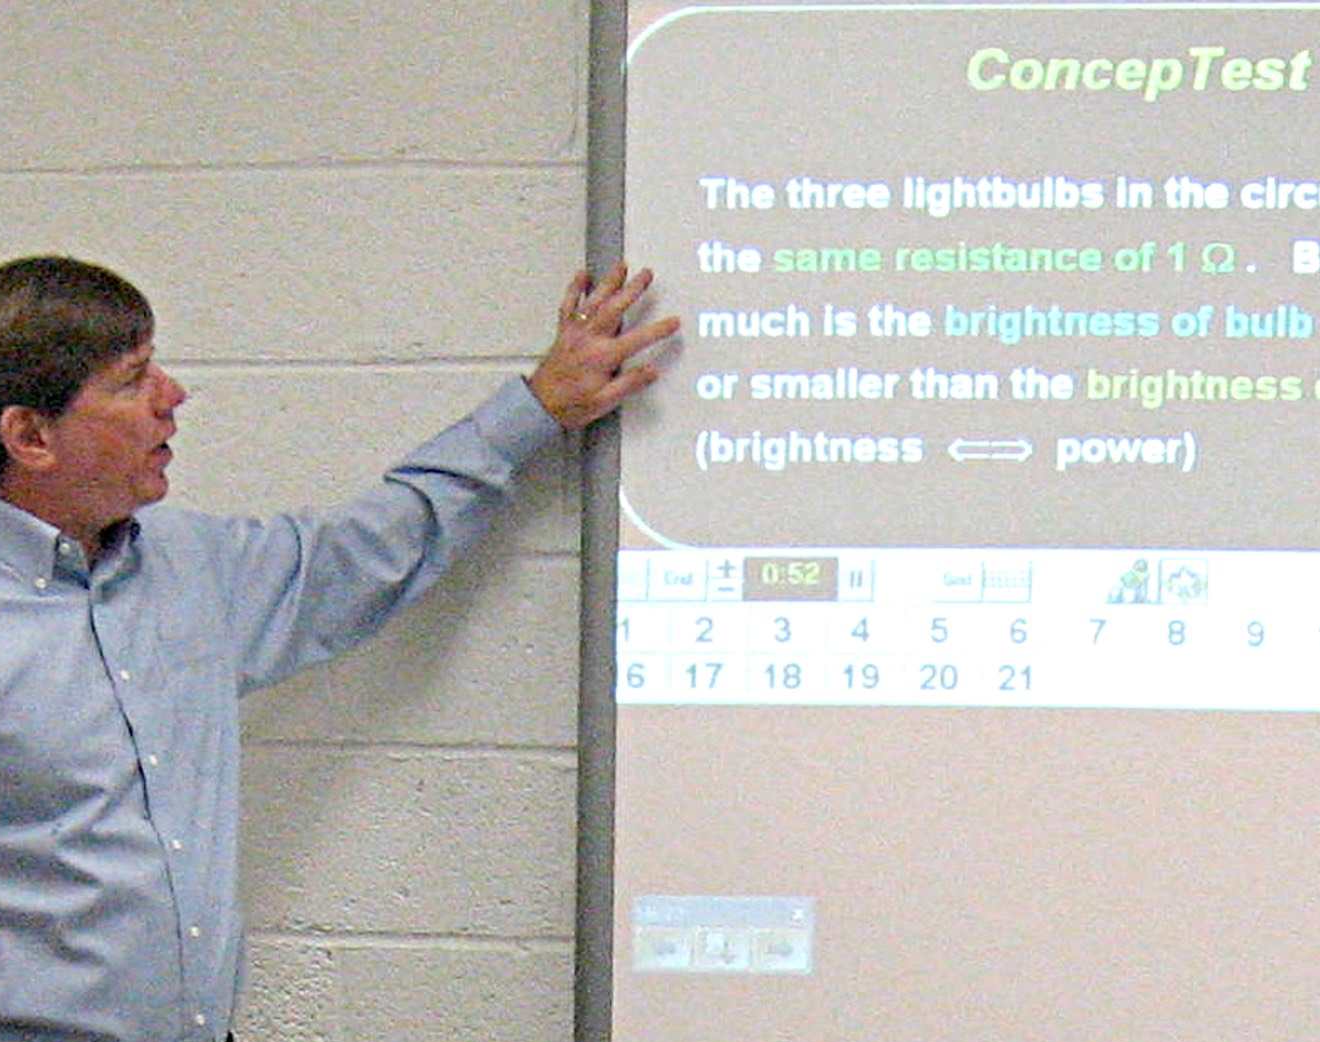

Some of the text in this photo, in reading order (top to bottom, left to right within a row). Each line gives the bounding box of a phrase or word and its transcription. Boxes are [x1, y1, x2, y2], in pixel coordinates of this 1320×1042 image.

[968, 47, 1311, 100] ConcepTest
[700, 175, 774, 209] The
[786, 177, 890, 208] three
[904, 176, 1103, 217] lightbulbs
[1117, 176, 1152, 208] in
[1164, 176, 1229, 208] the
[697, 240, 761, 272] the
[774, 249, 881, 272] same
[896, 242, 1101, 271] resistance
[1115, 242, 1155, 272] of
[1168, 242, 1183, 271] 1
[699, 304, 810, 337] much
[824, 304, 857, 337] is
[868, 303, 931, 336] the
[945, 304, 1159, 344] brightness
[1172, 305, 1213, 336] of
[1226, 304, 1312, 338] bulb
[697, 372, 739, 399] or
[751, 366, 900, 399] smaller
[910, 367, 999, 399] than
[1010, 366, 1073, 399] the
[1088, 369, 1301, 409] brightness
[696, 430, 1195, 472] (brightness power)
[762, 562, 821, 585] 0:52
[696, 617, 713, 643] 2
[775, 616, 792, 643] 3
[851, 617, 869, 641] 4
[931, 617, 948, 643] 5
[1010, 618, 1027, 644] 6
[1090, 618, 1107, 642] 7
[1168, 620, 1186, 646] 8
[1248, 620, 1265, 647] 9
[686, 662, 723, 688] 17
[766, 663, 802, 689] 18
[844, 663, 879, 689] 19
[920, 664, 958, 690] 20
[999, 665, 1031, 691] 21
